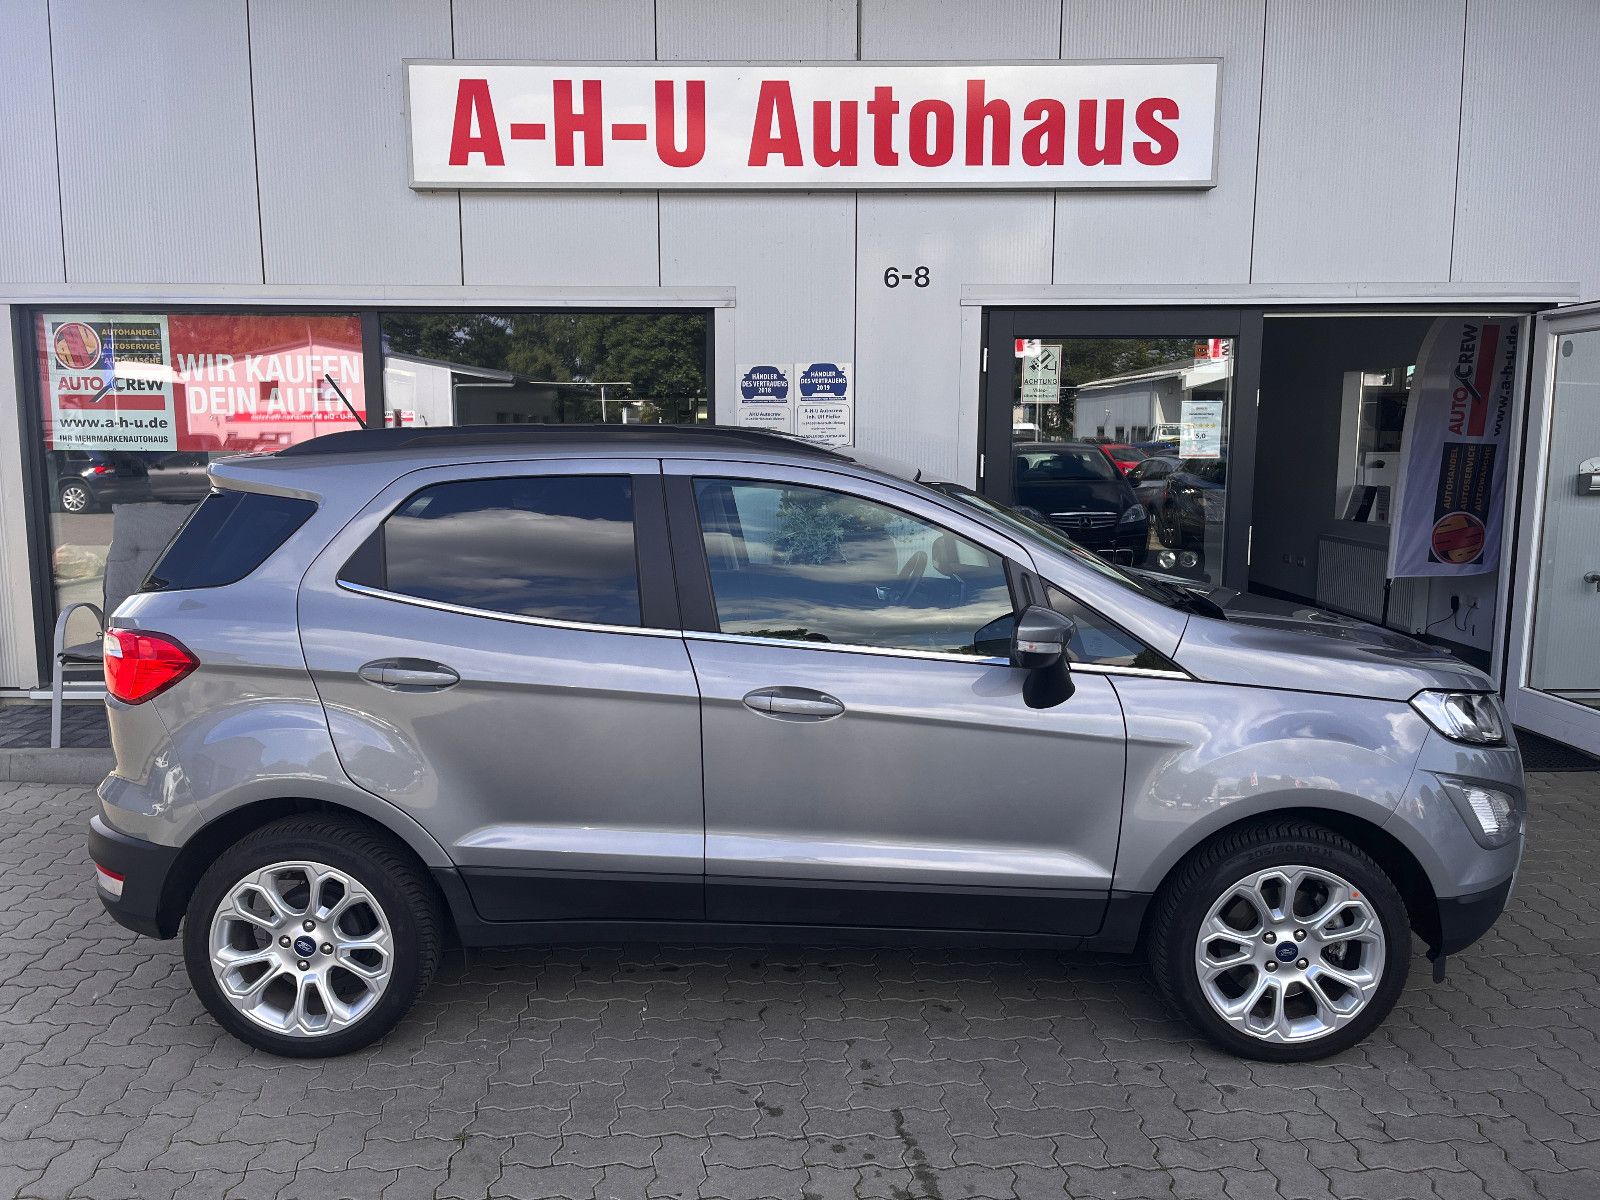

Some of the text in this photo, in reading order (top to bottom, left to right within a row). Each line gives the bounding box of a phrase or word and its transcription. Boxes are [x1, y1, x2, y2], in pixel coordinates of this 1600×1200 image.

[449, 79, 1179, 168] A-H-U Autohaus
[884, 266, 930, 288] 6-8
[102, 328, 157, 336] AUTOHANDEL
[177, 354, 360, 384] WIR KAUFEN
[58, 376, 164, 391] AUTO CREW
[1024, 378, 1057, 386] ACHTUNG
[1449, 324, 1478, 435] AUTO CREW
[189, 387, 256, 414] DEIN
[60, 417, 168, 428] www.a-h-u.de
[75, 435, 168, 443] MEHRMARKENAUTOHAUS
